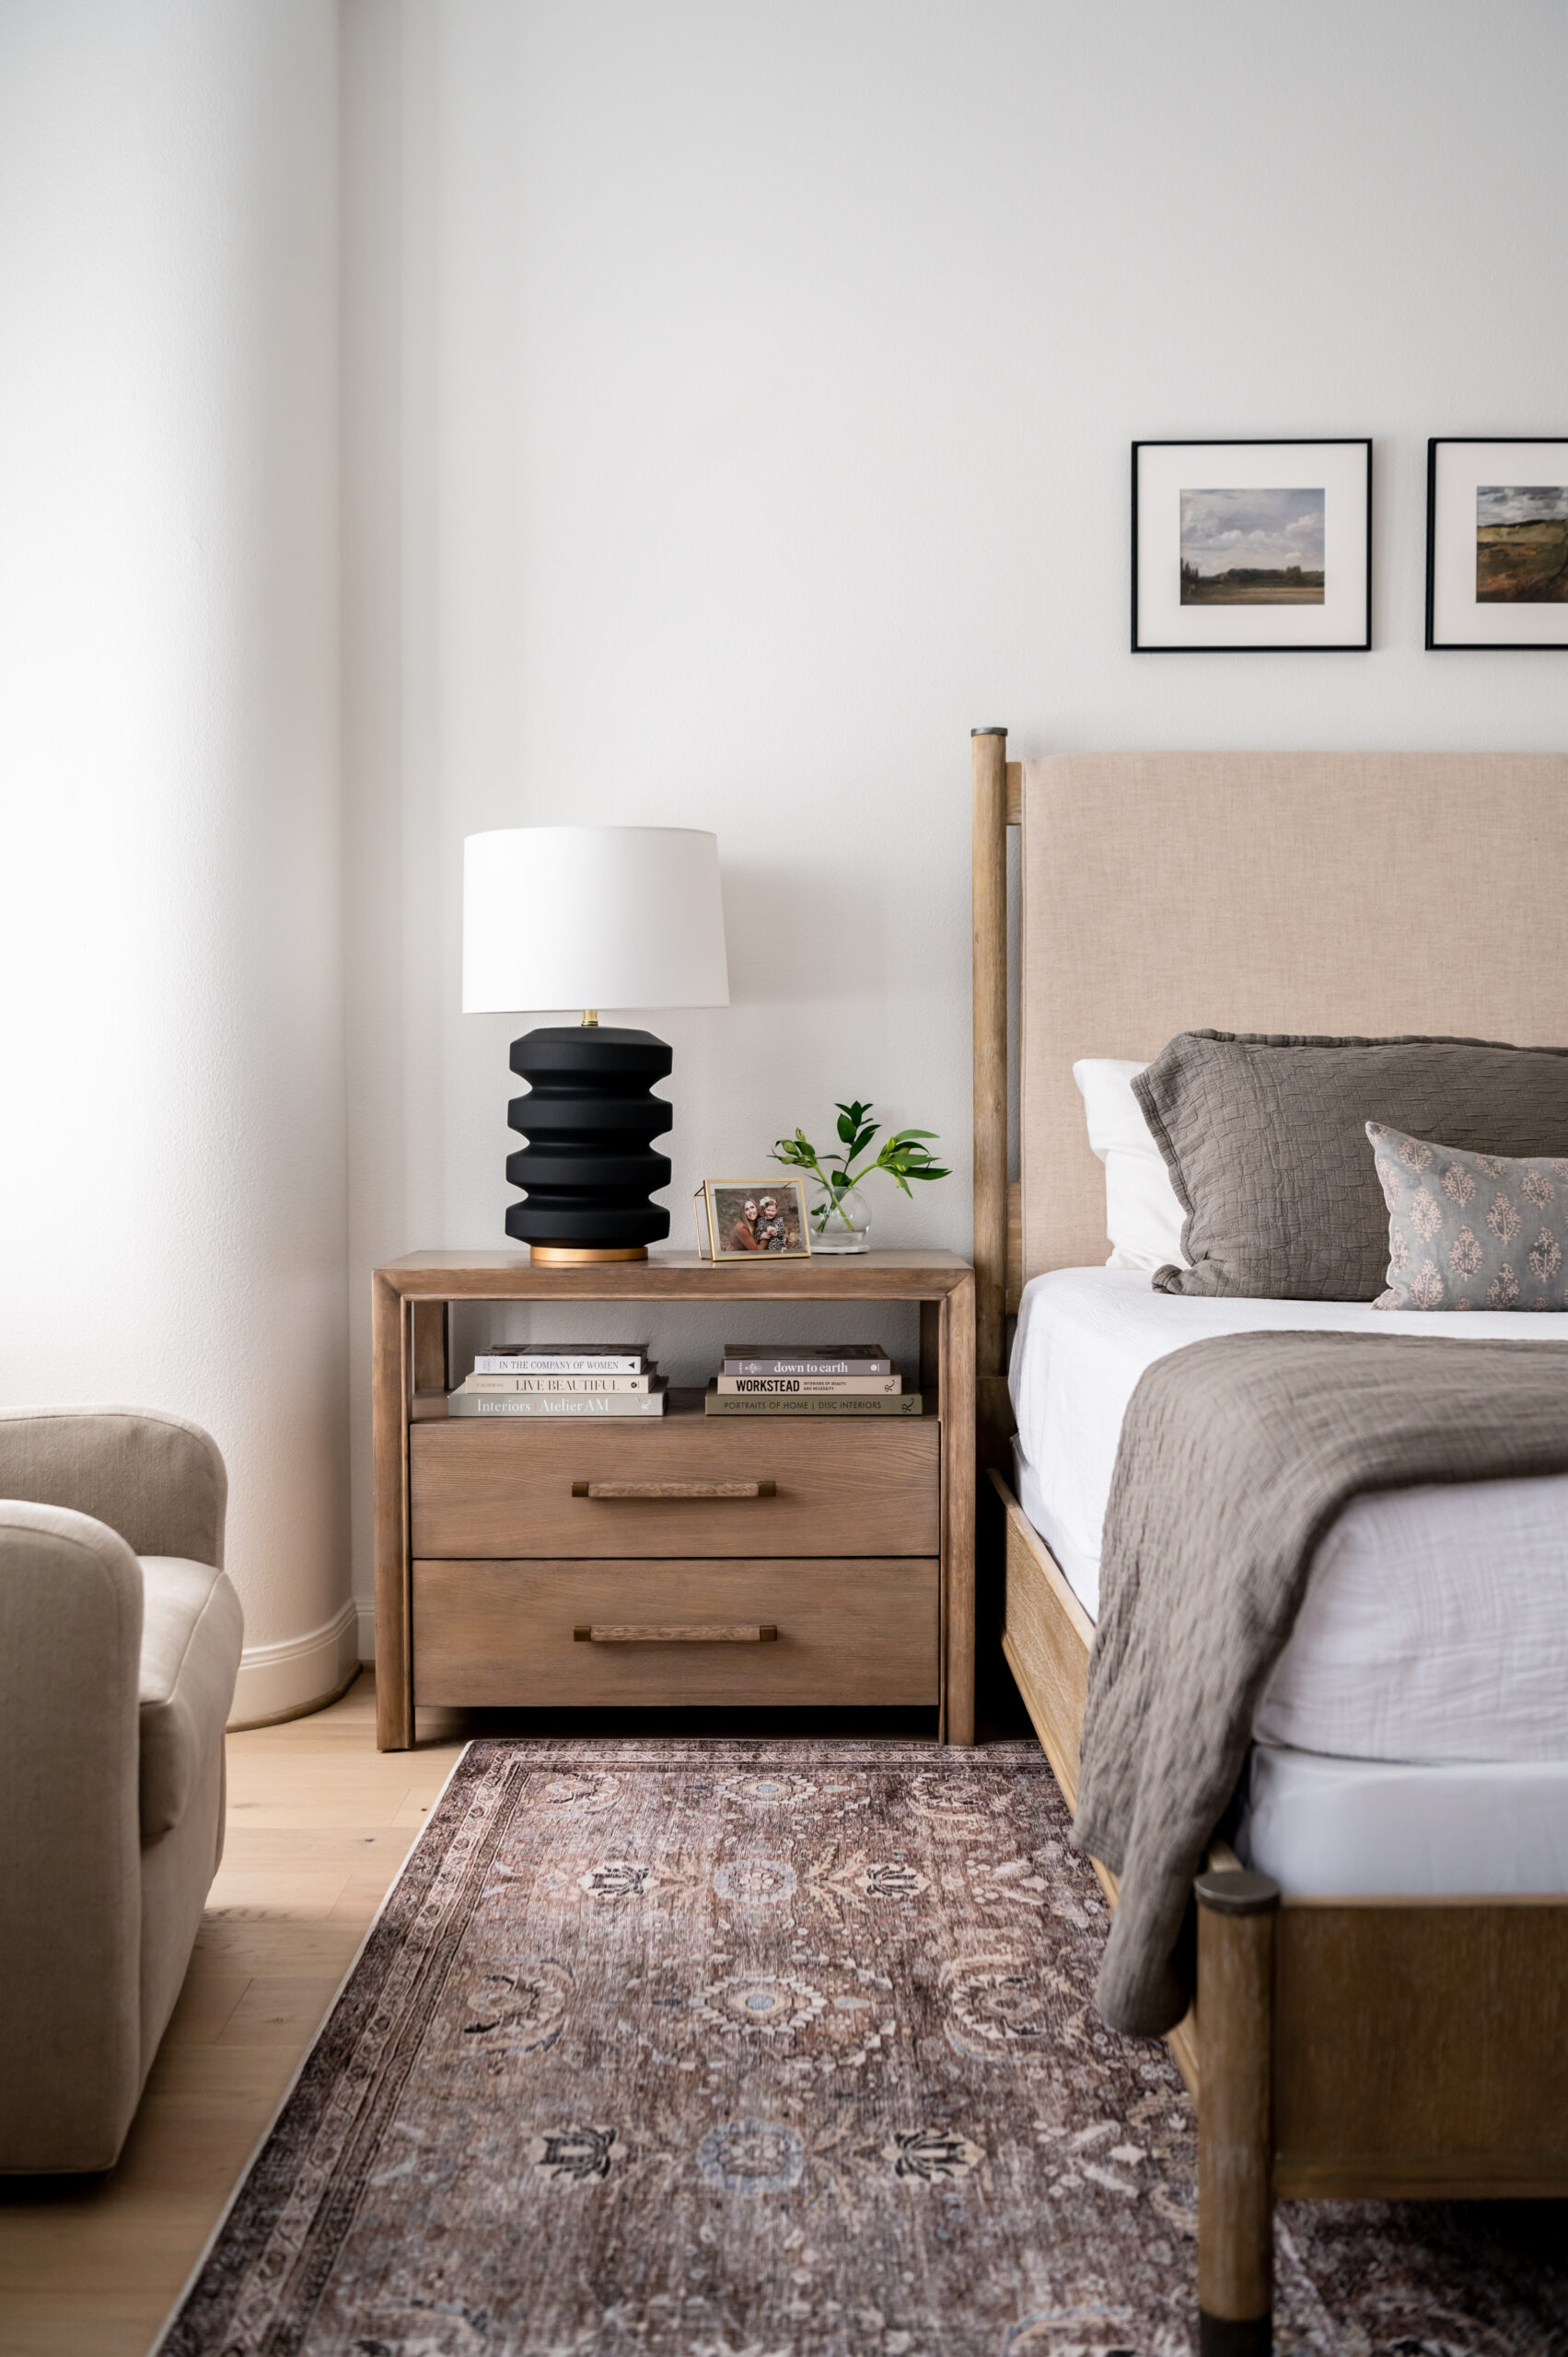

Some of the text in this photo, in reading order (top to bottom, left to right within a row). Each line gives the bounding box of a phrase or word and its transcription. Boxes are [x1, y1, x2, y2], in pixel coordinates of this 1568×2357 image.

[499, 1361, 508, 1370] IN
[511, 1361, 529, 1370] THE
[530, 1361, 571, 1370] COMPANY
[573, 1361, 585, 1370] OF
[587, 1361, 619, 1370] WOMEN
[773, 1362, 848, 1373] down to earth
[516, 1380, 620, 1391] LIVE BEAUTIFUL
[736, 1379, 800, 1392] WORKSTEAD
[477, 1398, 610, 1412] Interiors Atelier AM
[724, 1400, 882, 1410] PORTRAITS OF HOME DISC INTERIORS
